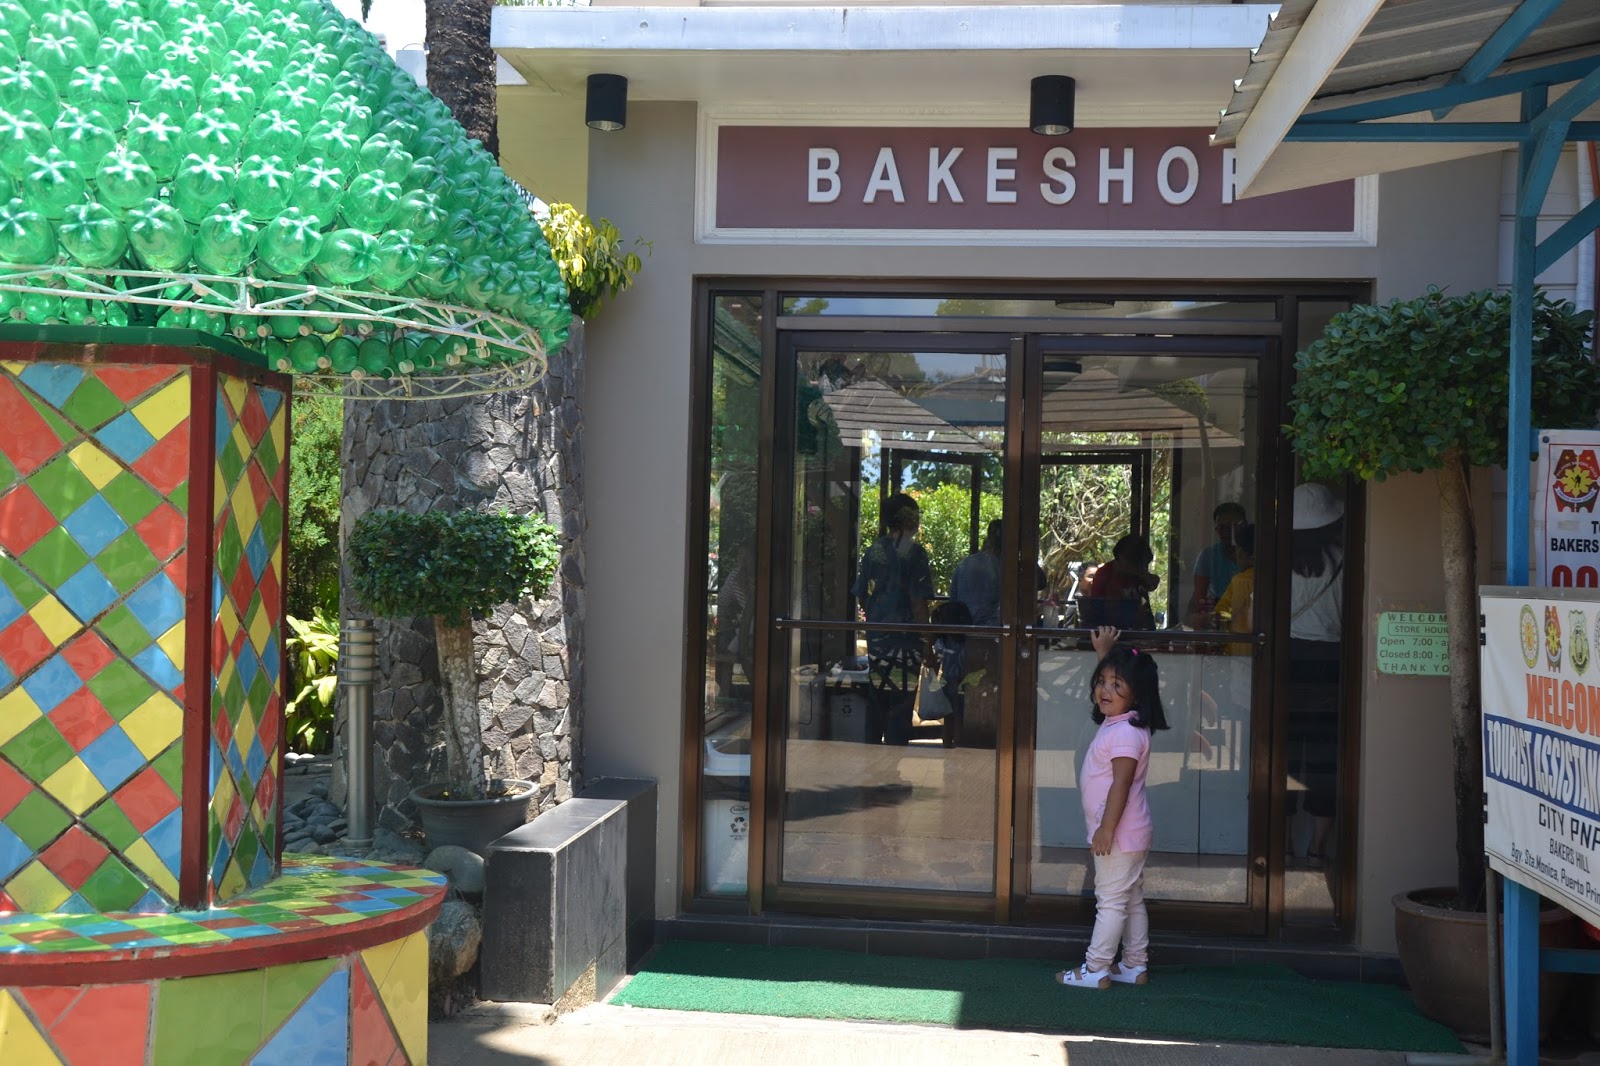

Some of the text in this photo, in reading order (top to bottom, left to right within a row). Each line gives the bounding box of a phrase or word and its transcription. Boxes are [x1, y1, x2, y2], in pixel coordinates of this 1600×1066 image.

[1591, 521, 1600, 534] T
[1551, 537, 1599, 553] BAKERS
[1395, 625, 1420, 633] STORE
[1380, 637, 1405, 647] Open
[1412, 638, 1433, 646] 7:00
[1380, 650, 1410, 658] Closed
[1413, 650, 1433, 659] 8:00
[1383, 663, 1426, 672] THANK
[1487, 719, 1600, 815] TOURIST ASSISTAN
[1538, 803, 1564, 836] CITY
[1549, 838, 1590, 874] BAKERS HILL
[1561, 868, 1584, 895] Puerto
